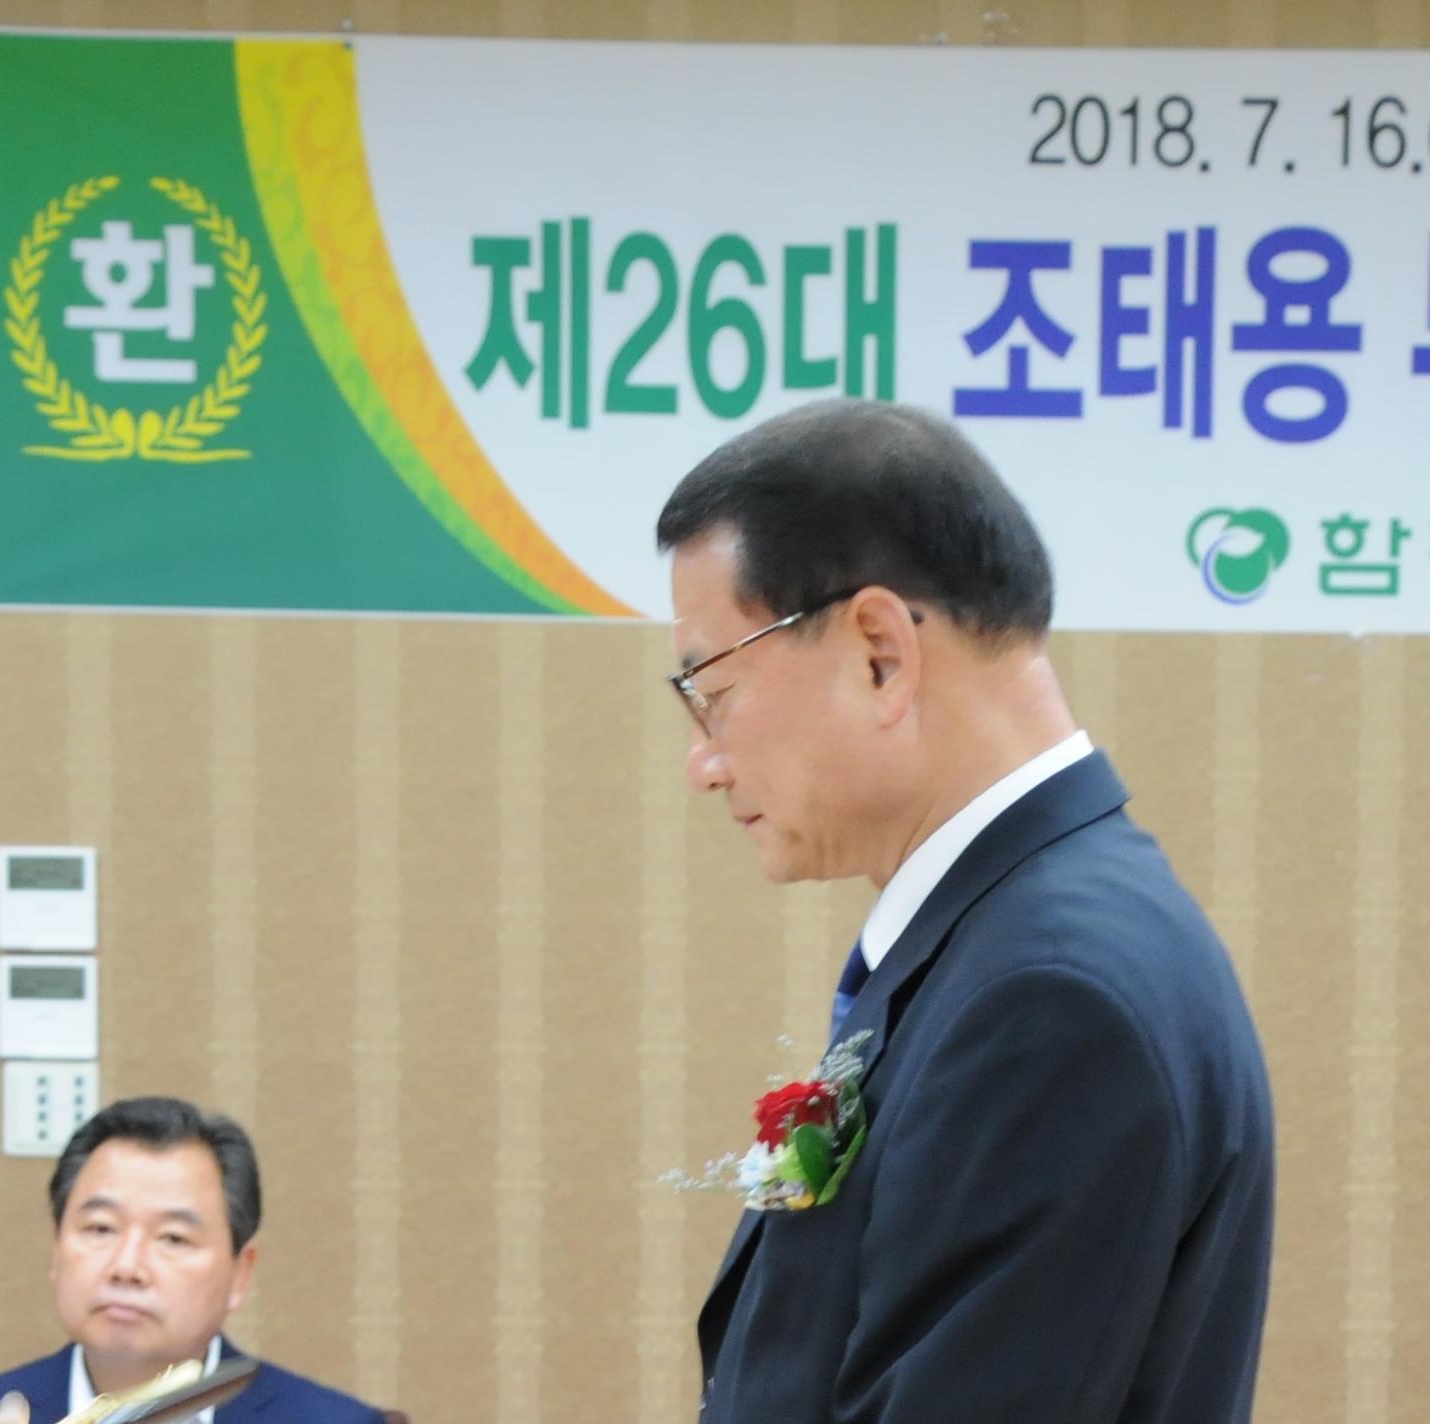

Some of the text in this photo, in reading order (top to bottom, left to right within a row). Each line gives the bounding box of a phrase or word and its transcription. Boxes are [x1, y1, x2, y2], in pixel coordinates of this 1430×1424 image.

[1029, 94, 1212, 174] 2018.
[1241, 98, 1296, 174] 7.
[64, 219, 216, 384] 환
[463, 216, 898, 430] 제26대
[950, 224, 1364, 445] 조태용
